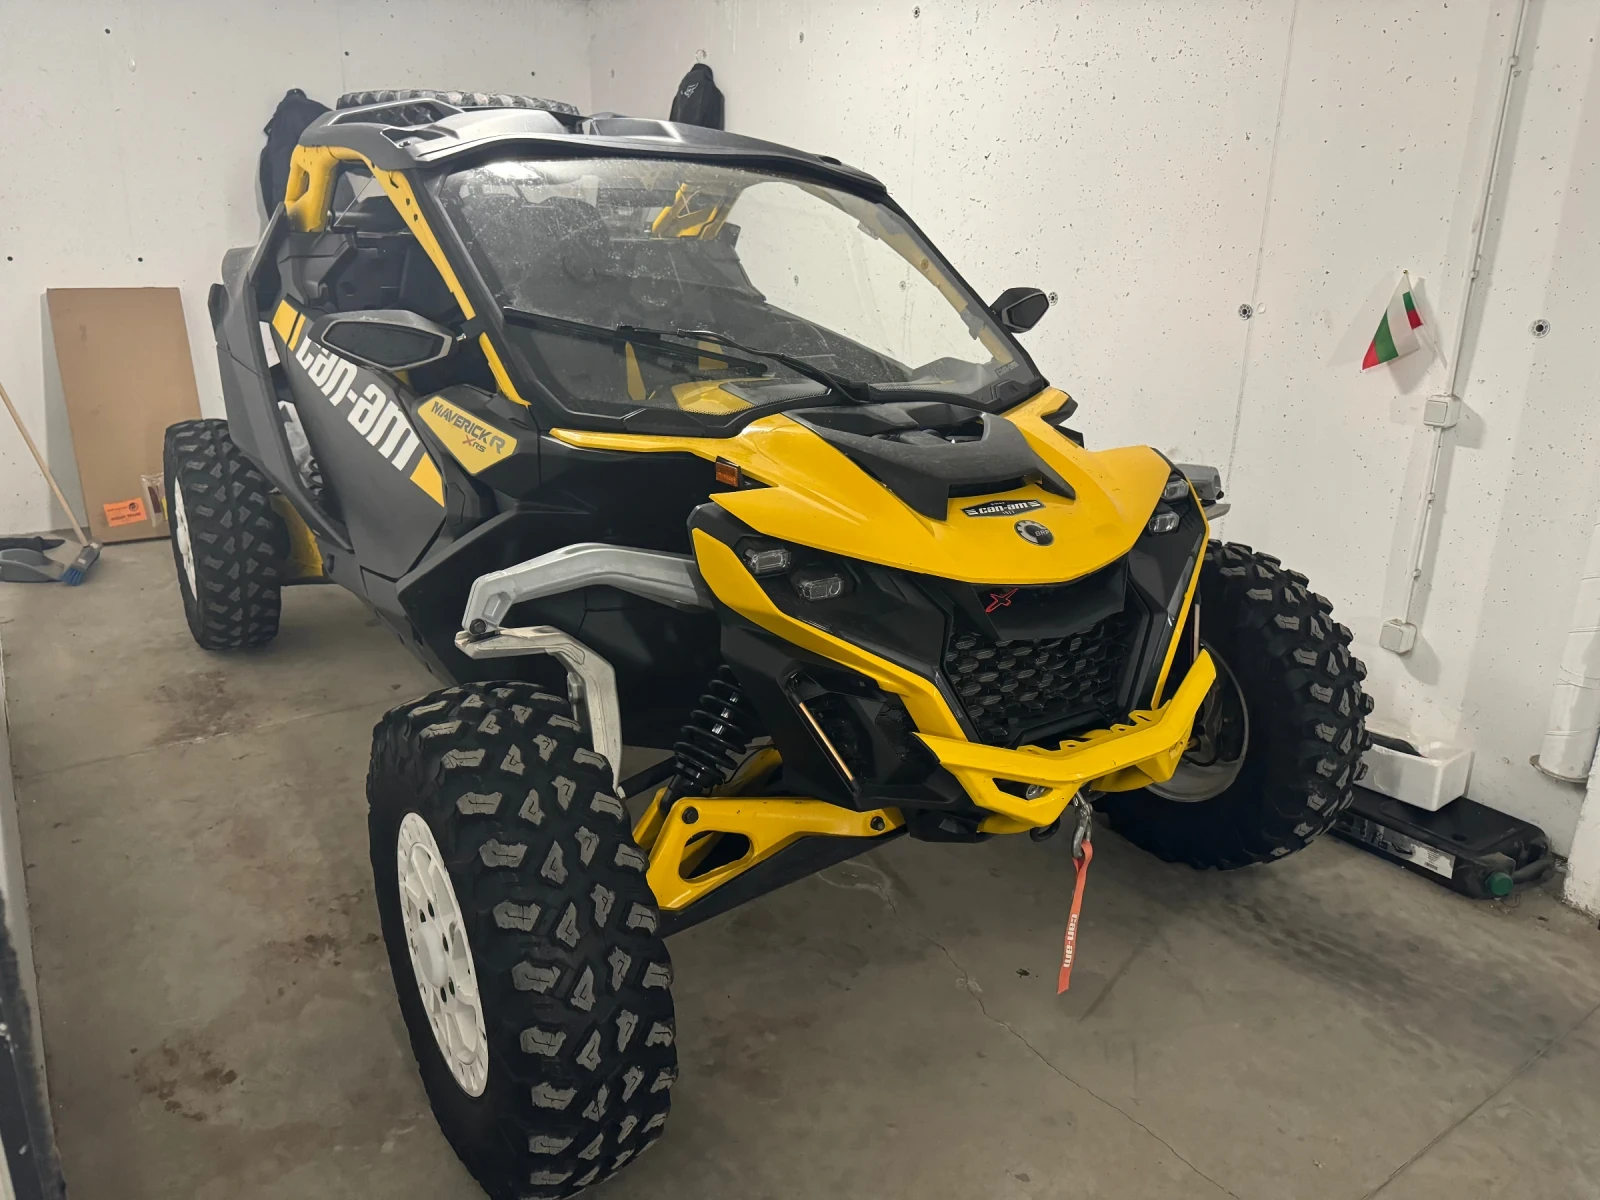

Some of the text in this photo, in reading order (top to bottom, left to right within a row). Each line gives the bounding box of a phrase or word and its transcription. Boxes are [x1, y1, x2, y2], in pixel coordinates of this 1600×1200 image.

[431, 401, 506, 455] MAVERICK R
[978, 502, 1028, 514] can-am
[1063, 913, 1078, 968] can-am
